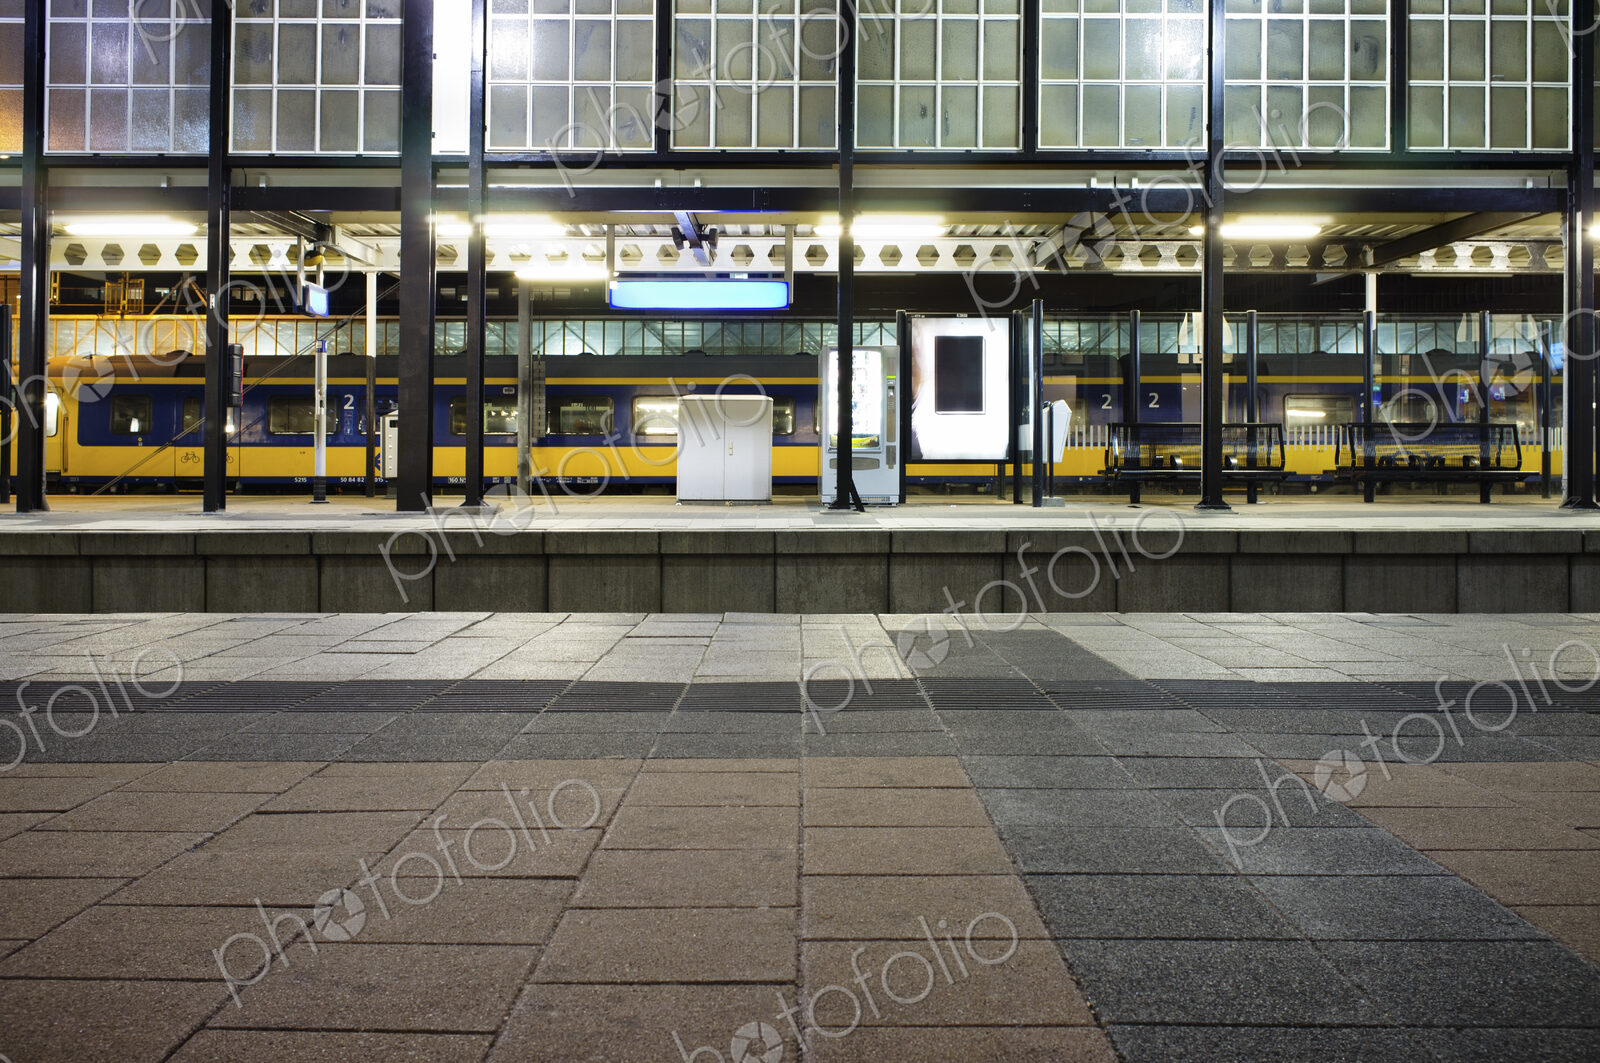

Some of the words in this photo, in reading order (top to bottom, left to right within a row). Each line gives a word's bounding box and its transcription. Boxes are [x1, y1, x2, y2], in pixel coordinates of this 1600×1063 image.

[343, 394, 355, 410] 2
[1102, 394, 1112, 409] 2
[1148, 392, 1159, 407] 2
